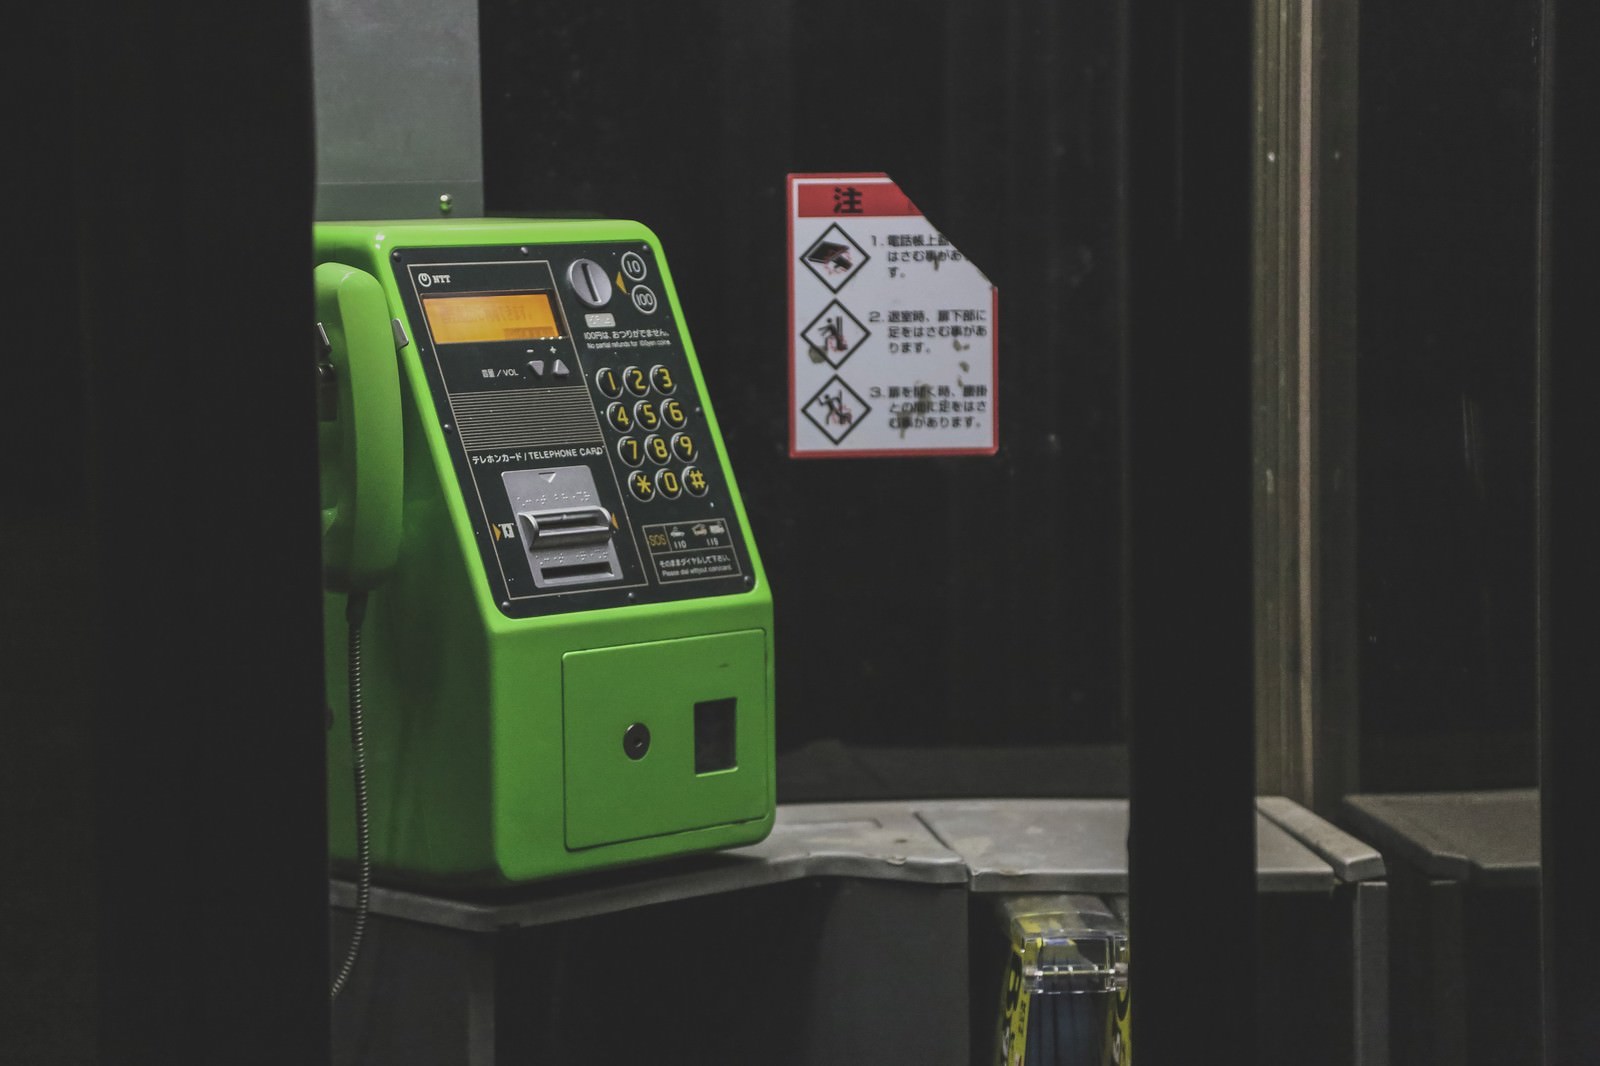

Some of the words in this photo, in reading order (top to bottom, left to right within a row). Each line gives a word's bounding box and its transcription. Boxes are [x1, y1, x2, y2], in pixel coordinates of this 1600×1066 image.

[833, 186, 863, 214] 注
[627, 260, 641, 273] 10
[432, 274, 451, 284] NTT
[636, 293, 654, 306] 100
[632, 369, 646, 390] 2
[659, 368, 673, 388] 3
[617, 406, 629, 425] 4
[643, 404, 657, 424] 5
[669, 402, 684, 421] 6
[472, 452, 523, 465] テレホンカード
[528, 449, 578, 460] TELEPHONE
[579, 447, 604, 456] CARD
[627, 440, 637, 460] 7
[653, 438, 668, 458] 8
[680, 436, 692, 456] 9
[663, 472, 678, 492] 0
[648, 533, 667, 546] SOS
